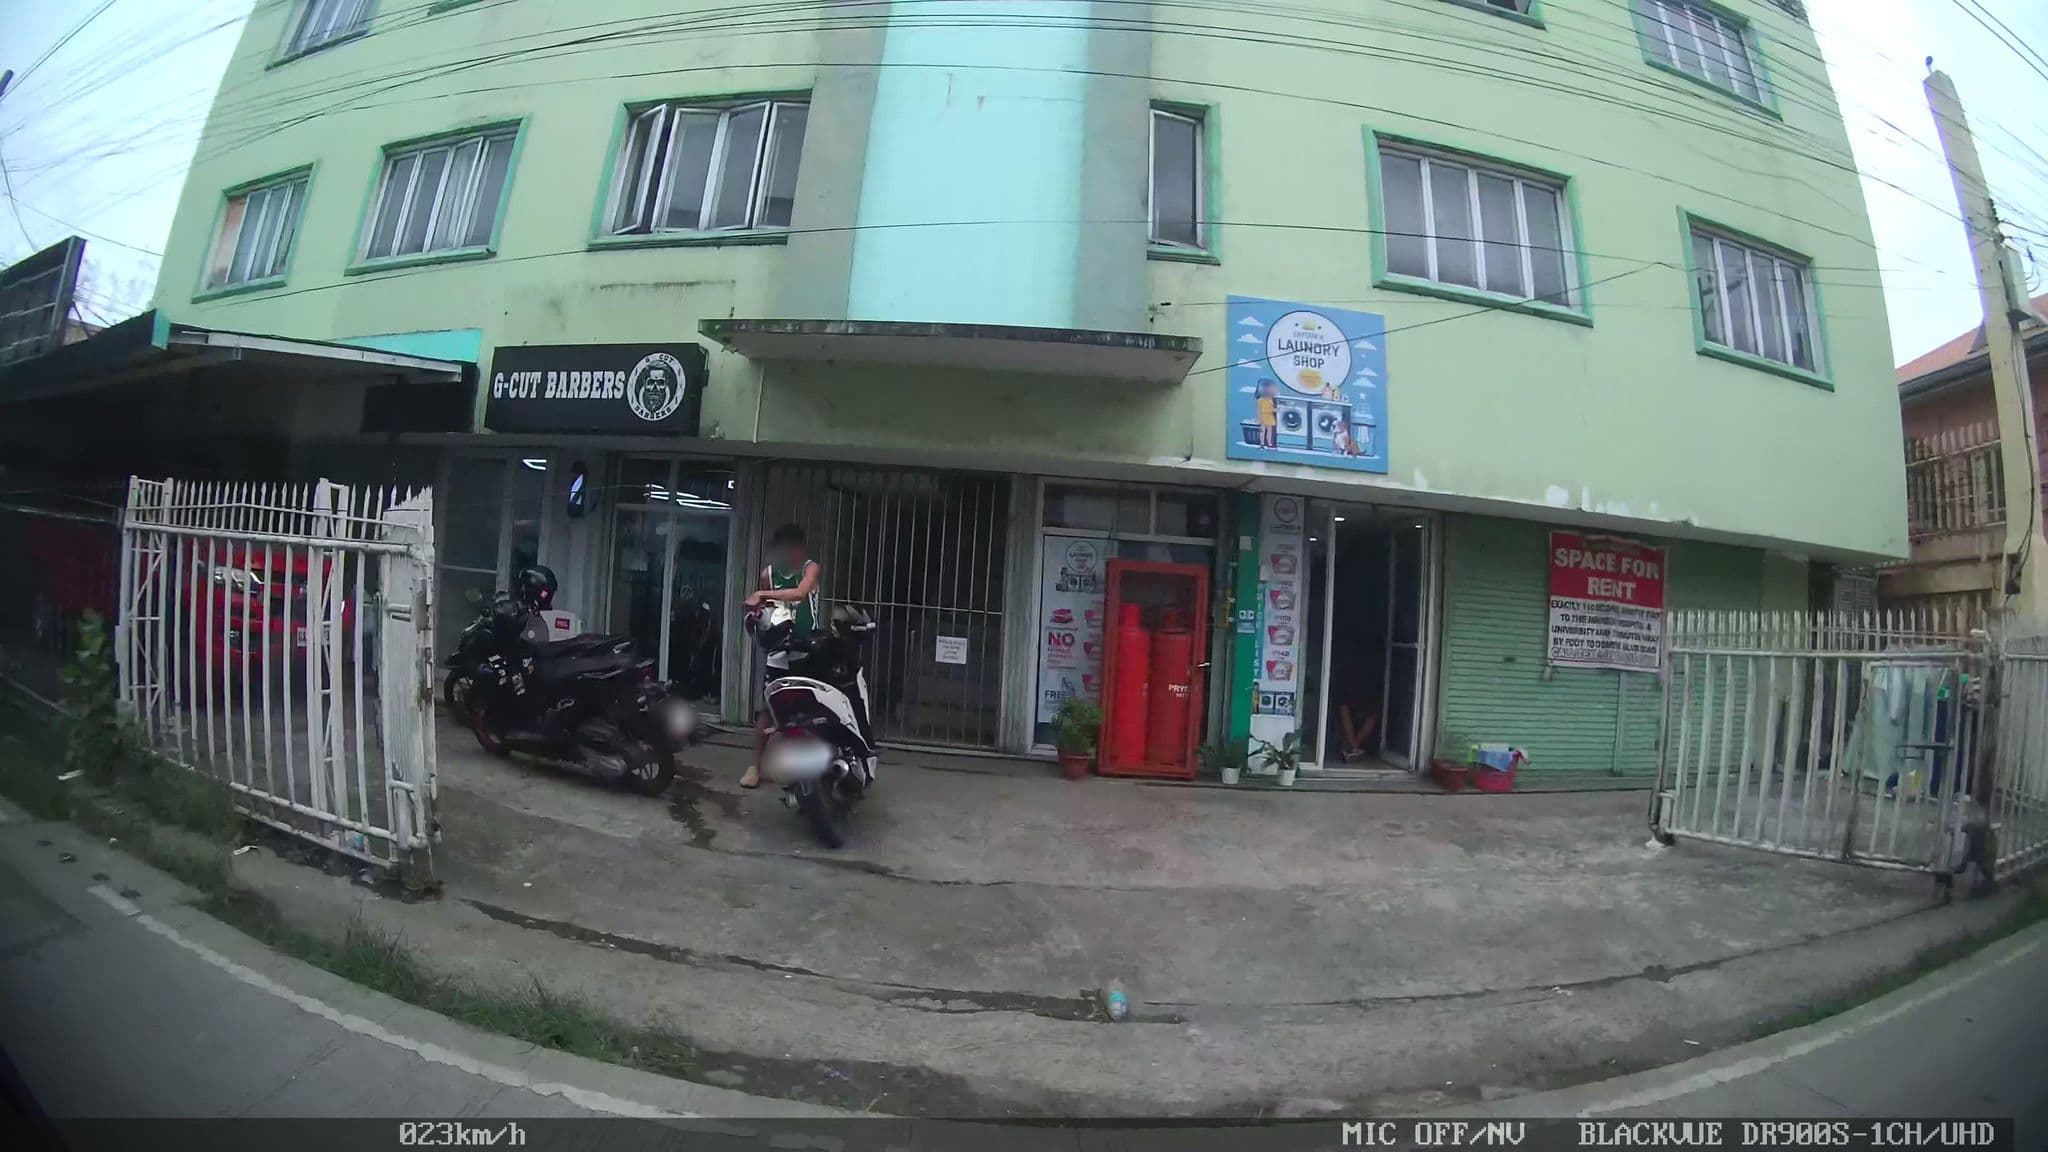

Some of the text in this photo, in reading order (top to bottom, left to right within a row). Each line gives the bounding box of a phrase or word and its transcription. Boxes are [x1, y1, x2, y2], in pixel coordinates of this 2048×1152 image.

[1278, 338, 1340, 357] LAUNDRY
[1293, 355, 1325, 369] SHOP
[493, 370, 626, 399] G-CUT BARBERS
[1555, 548, 1659, 580] SPACE FOR
[1587, 576, 1637, 601] RENT
[1560, 613, 1570, 622] TO
[1048, 631, 1075, 647] NO
[1553, 637, 1563, 646] BY
[1565, 638, 1585, 647] FOOT
[1586, 640, 1595, 648] TO
